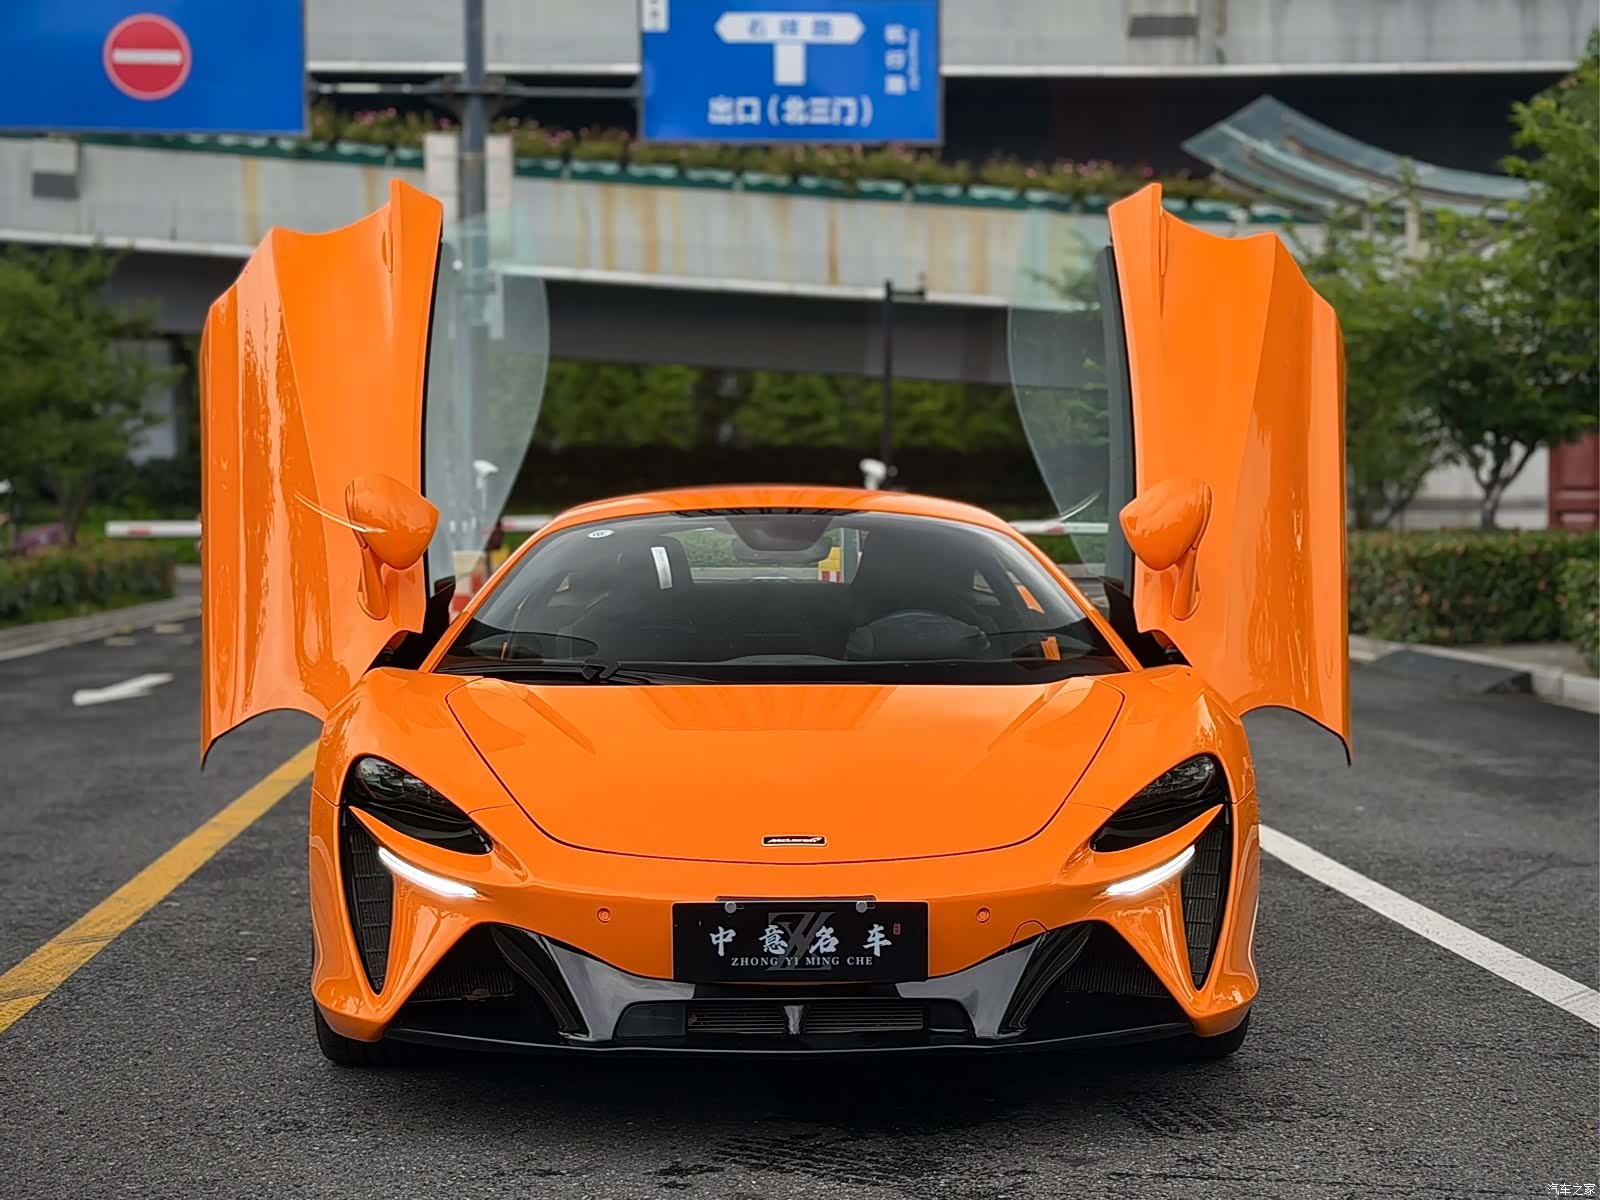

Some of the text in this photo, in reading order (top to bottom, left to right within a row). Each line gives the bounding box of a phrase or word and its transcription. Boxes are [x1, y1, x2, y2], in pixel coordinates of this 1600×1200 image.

[709, 923, 892, 957] 中意名车
[731, 956, 873, 967] ZHONG YI MING CHE
